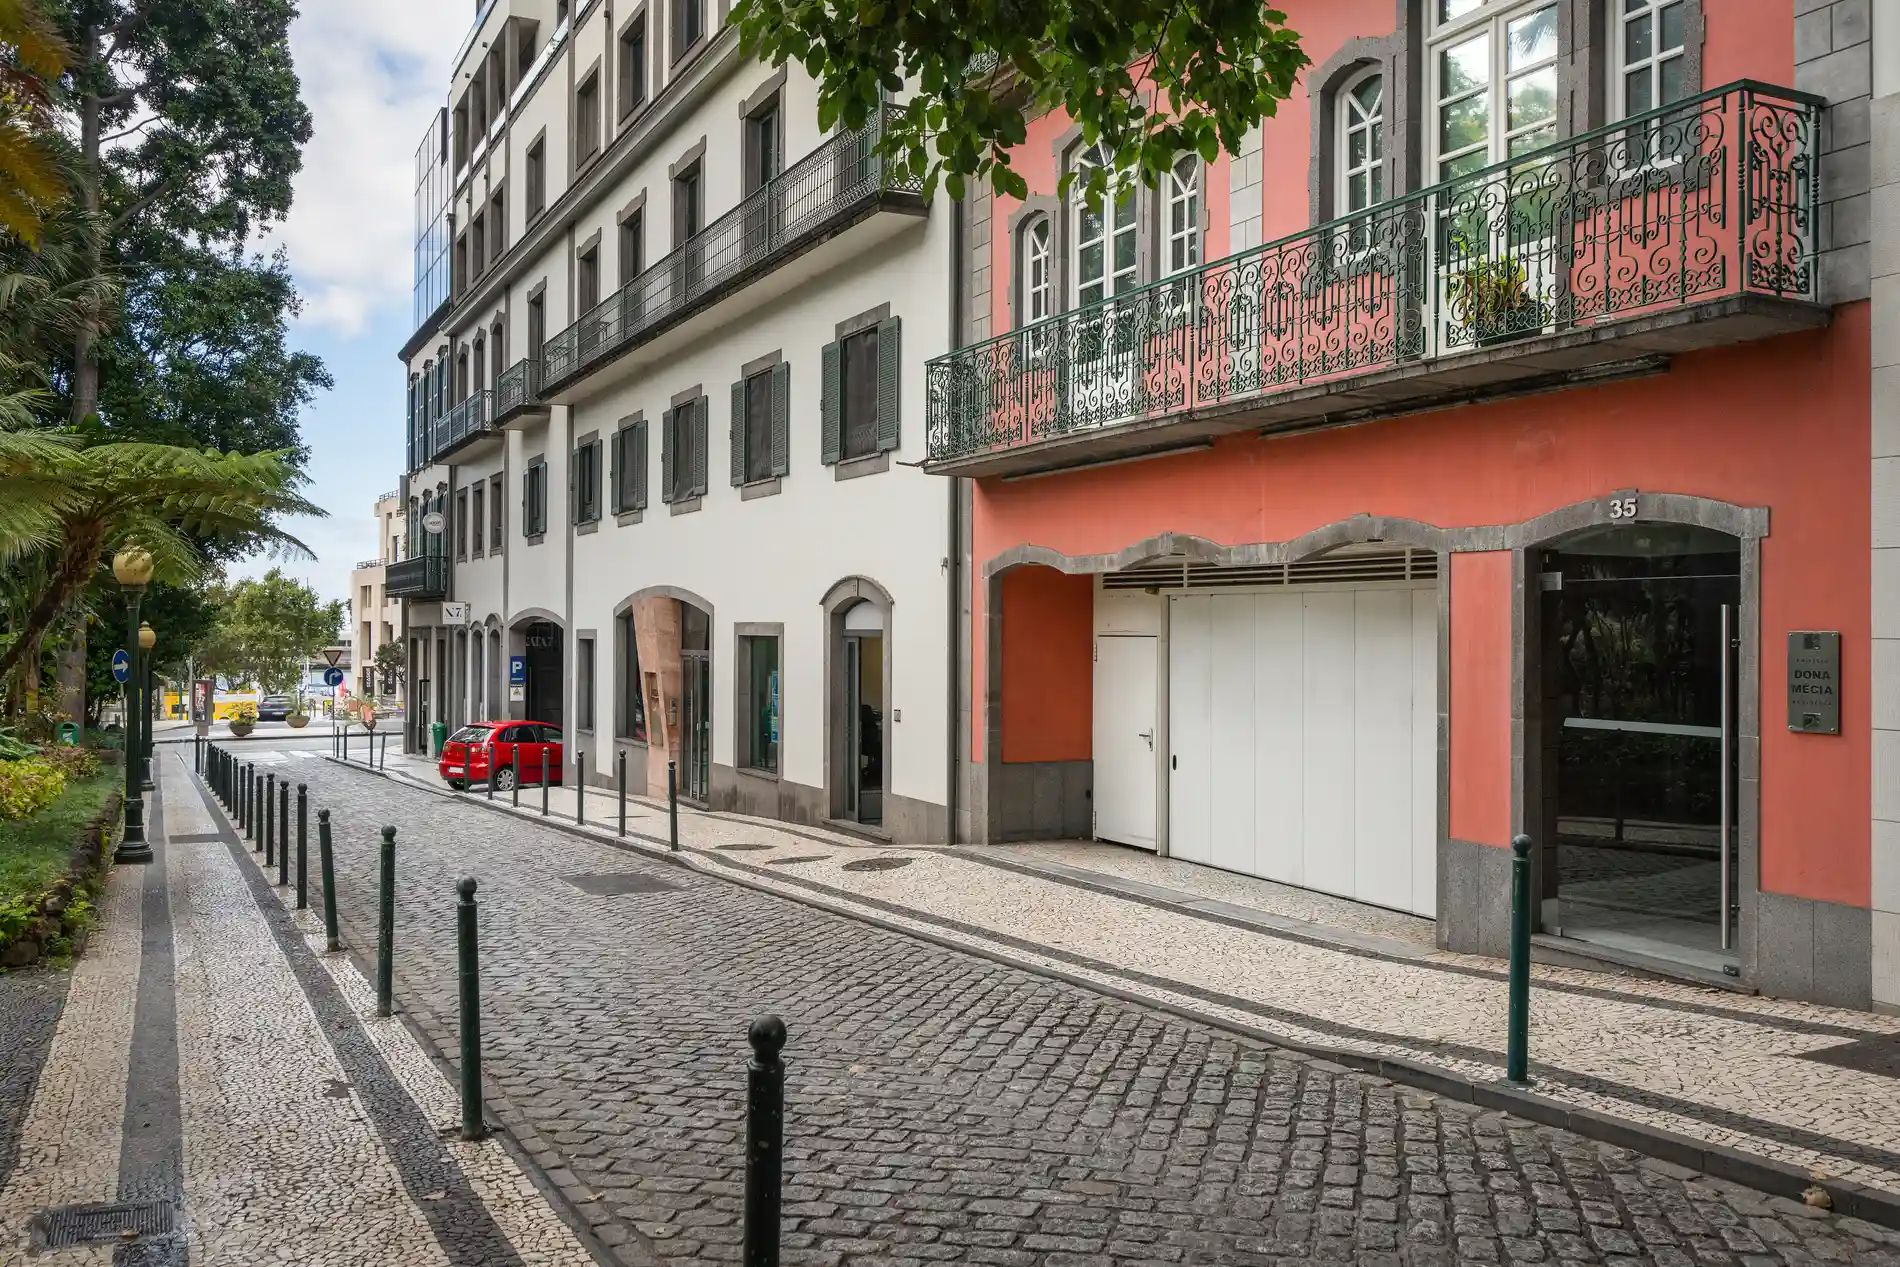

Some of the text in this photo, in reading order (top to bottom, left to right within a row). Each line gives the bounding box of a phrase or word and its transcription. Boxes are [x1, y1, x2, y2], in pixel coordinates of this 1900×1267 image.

[1609, 498, 1637, 519] 35
[512, 661, 522, 673] P
[1794, 670, 1831, 680] DONA
[1791, 683, 1833, 695] MÉCIA
